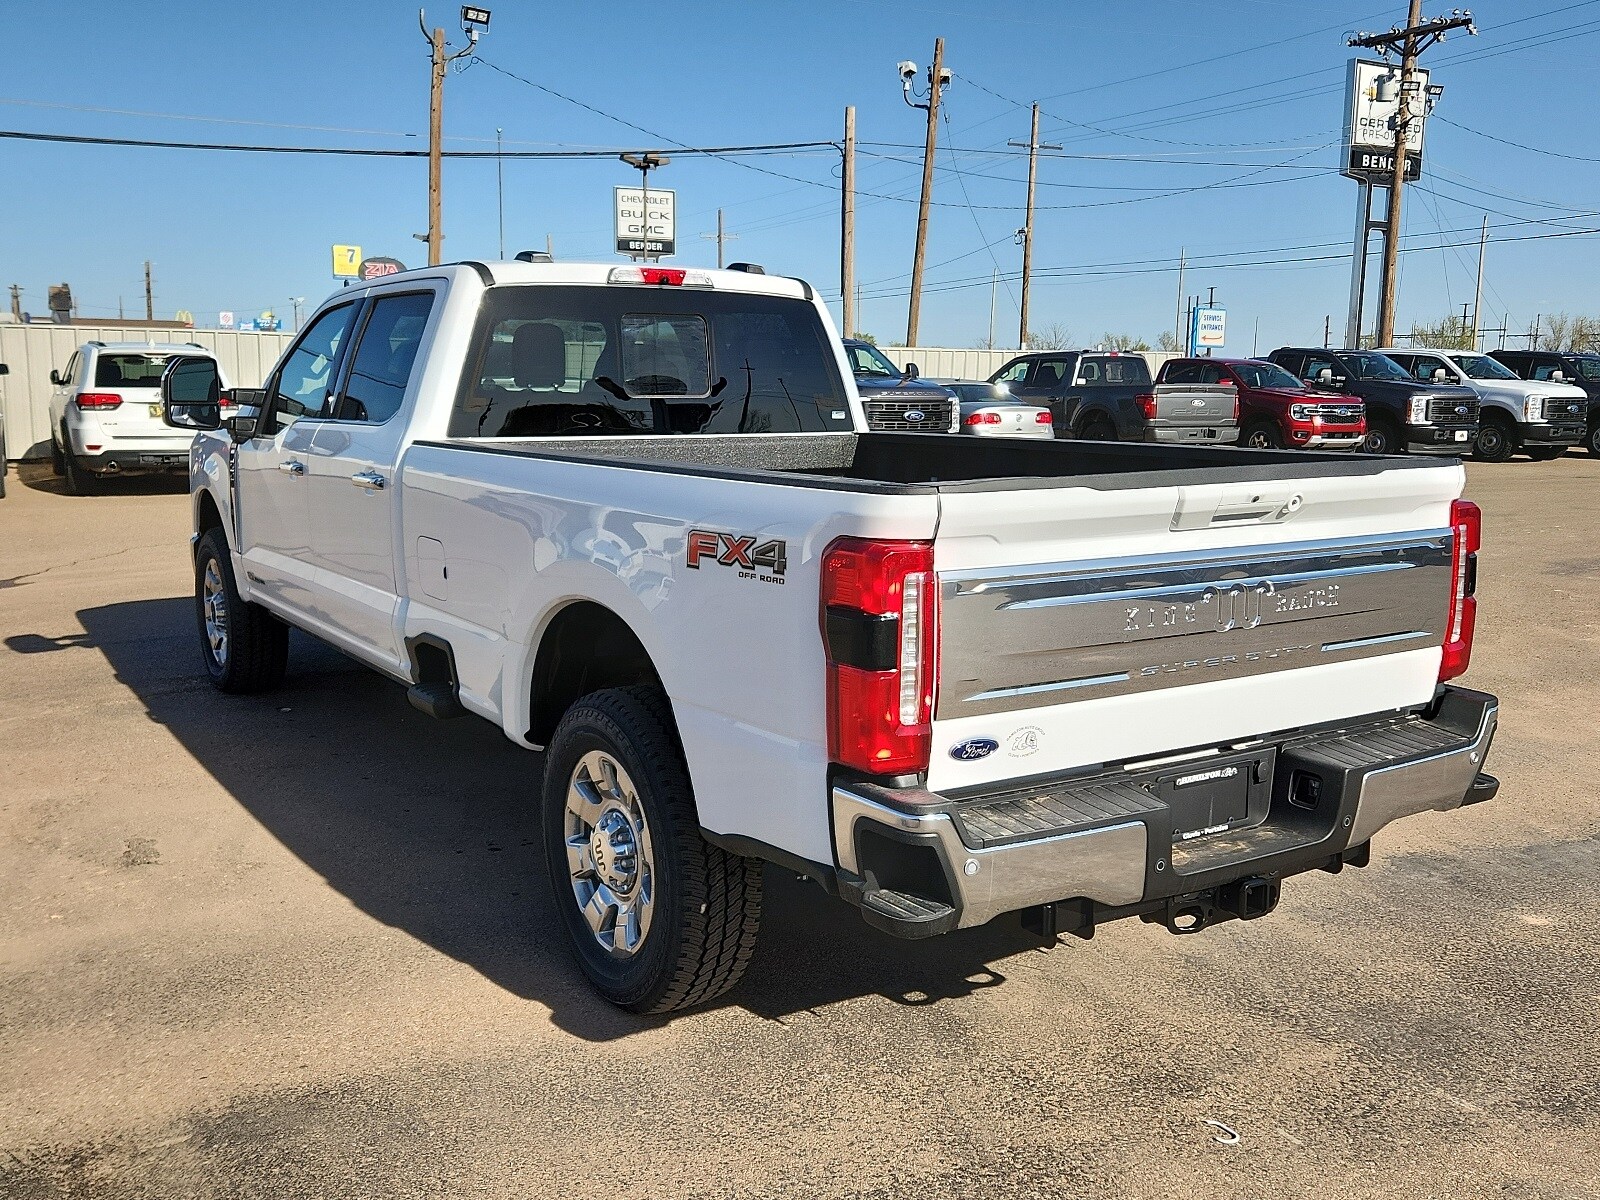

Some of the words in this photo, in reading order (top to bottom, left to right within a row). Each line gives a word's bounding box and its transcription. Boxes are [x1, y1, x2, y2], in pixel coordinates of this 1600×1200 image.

[1360, 117, 1421, 133] CERED
[1363, 128, 1417, 143] PRE-OWED
[1362, 154, 1412, 172] BENDR
[621, 209, 671, 220] BUCK
[628, 224, 664, 234] GMC
[346, 248, 355, 263] 7
[1203, 314, 1222, 322] SERVICE
[1200, 323, 1224, 331] ENTRANCE
[686, 529, 787, 576] FX4
[738, 571, 757, 580] OFF
[759, 574, 785, 585] ROAD
[1123, 603, 1196, 631] KING
[1275, 584, 1340, 613] RANCH
[1140, 654, 1239, 677] SUPER
[1181, 769, 1222, 784] HAMILTON
